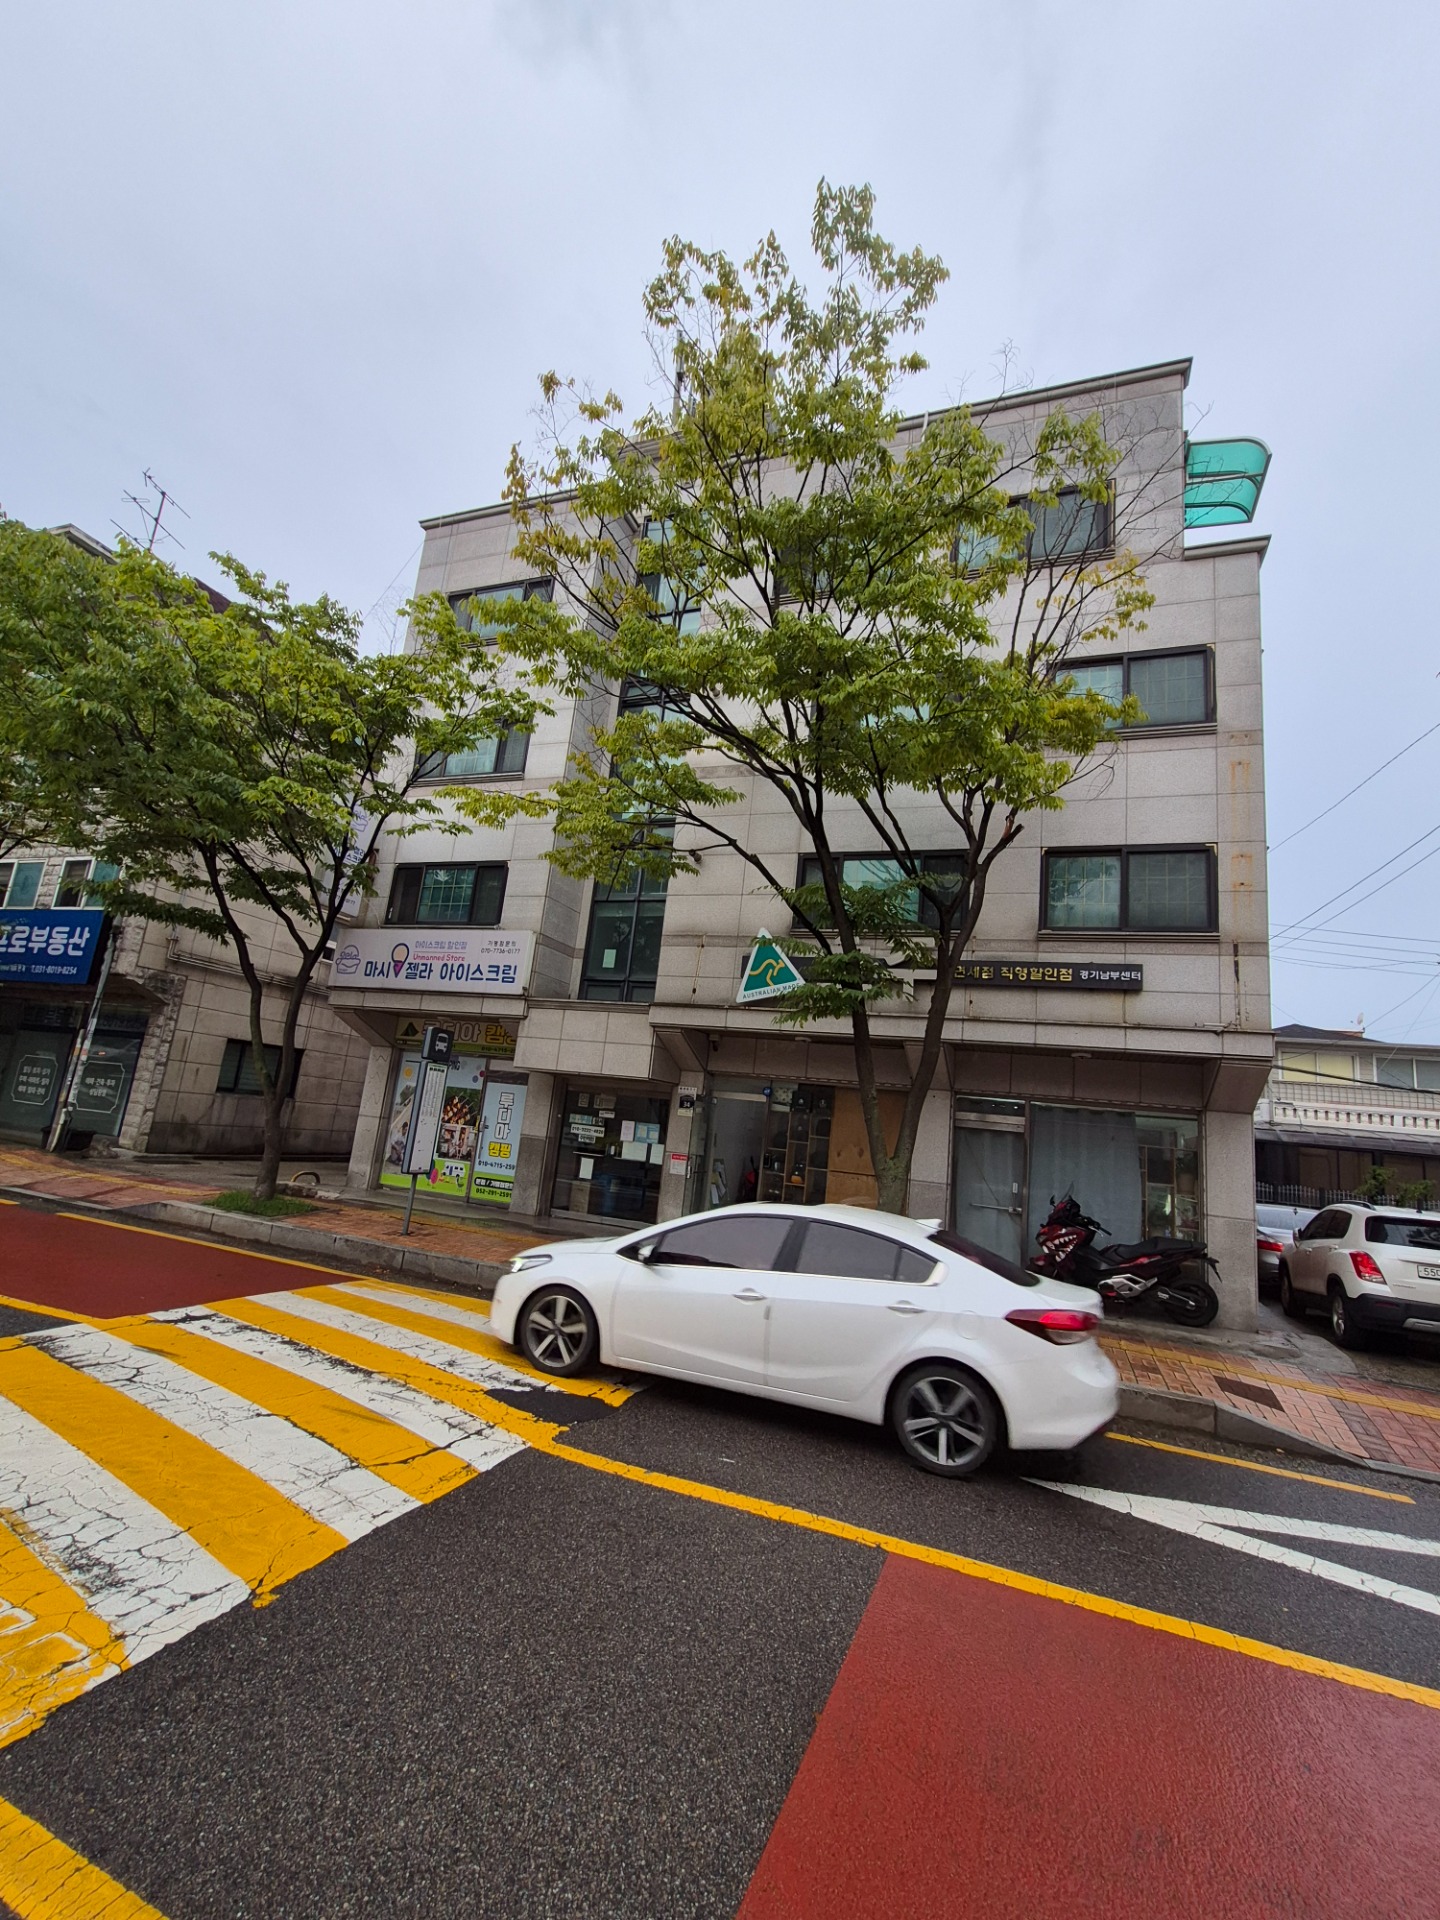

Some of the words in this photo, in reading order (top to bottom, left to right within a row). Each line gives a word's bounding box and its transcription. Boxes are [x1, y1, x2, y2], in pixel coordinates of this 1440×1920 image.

[415, 940, 446, 950] 아이스크림
[413, 953, 445, 962] Unmanned
[446, 953, 466, 962] Store
[440, 963, 518, 984] 아이스크림
[1000, 967, 1073, 982] 직영할인점
[1079, 969, 1142, 981] 경기남부센터
[742, 987, 781, 1000] AUSTRALIAN
[494, 1091, 515, 1140] 루디아
[488, 1141, 512, 1159] 캠핑
